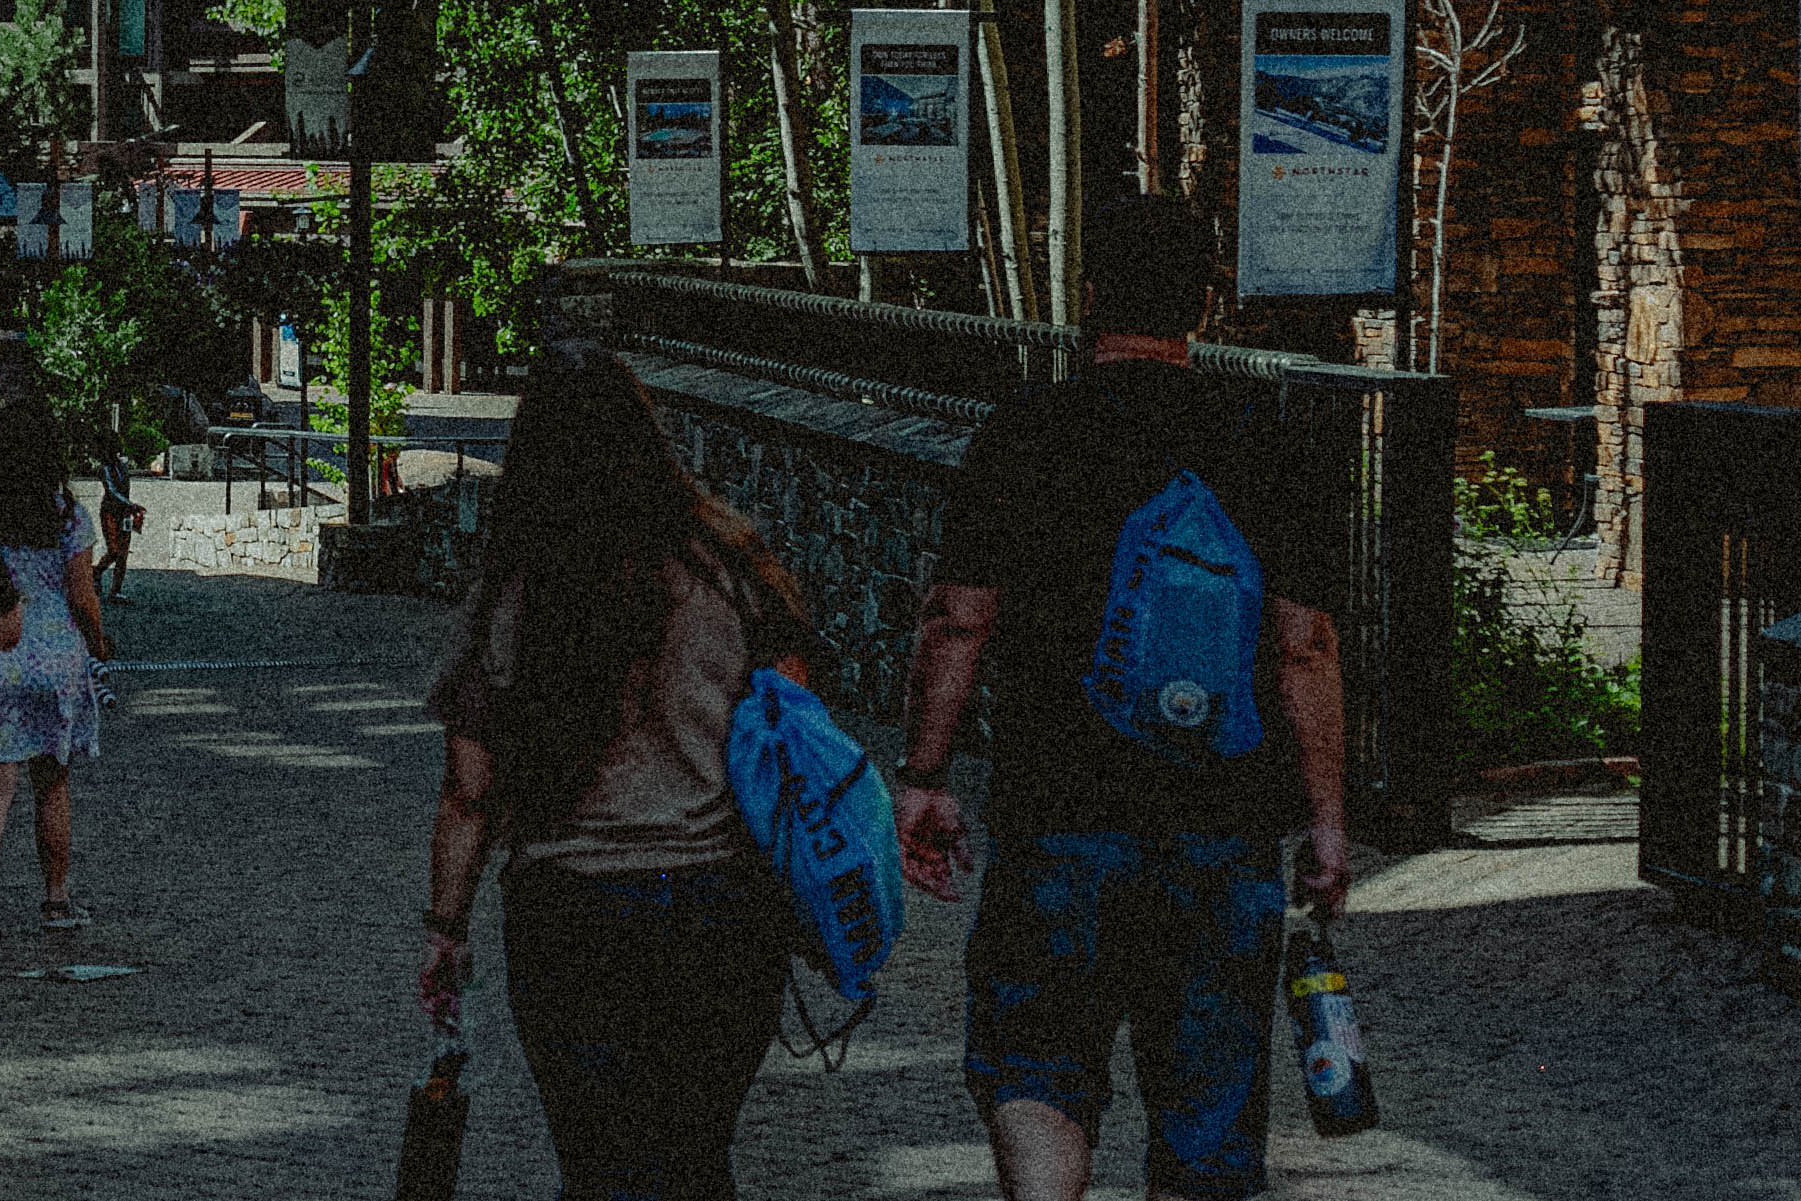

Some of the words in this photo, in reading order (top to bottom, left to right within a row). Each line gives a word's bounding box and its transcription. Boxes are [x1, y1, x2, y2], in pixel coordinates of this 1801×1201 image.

[1270, 27, 1317, 41] OWNERS
[1320, 27, 1375, 42] WELCOME
[1290, 166, 1369, 177] NORTHSTAR
[830, 866, 884, 965] MAN
